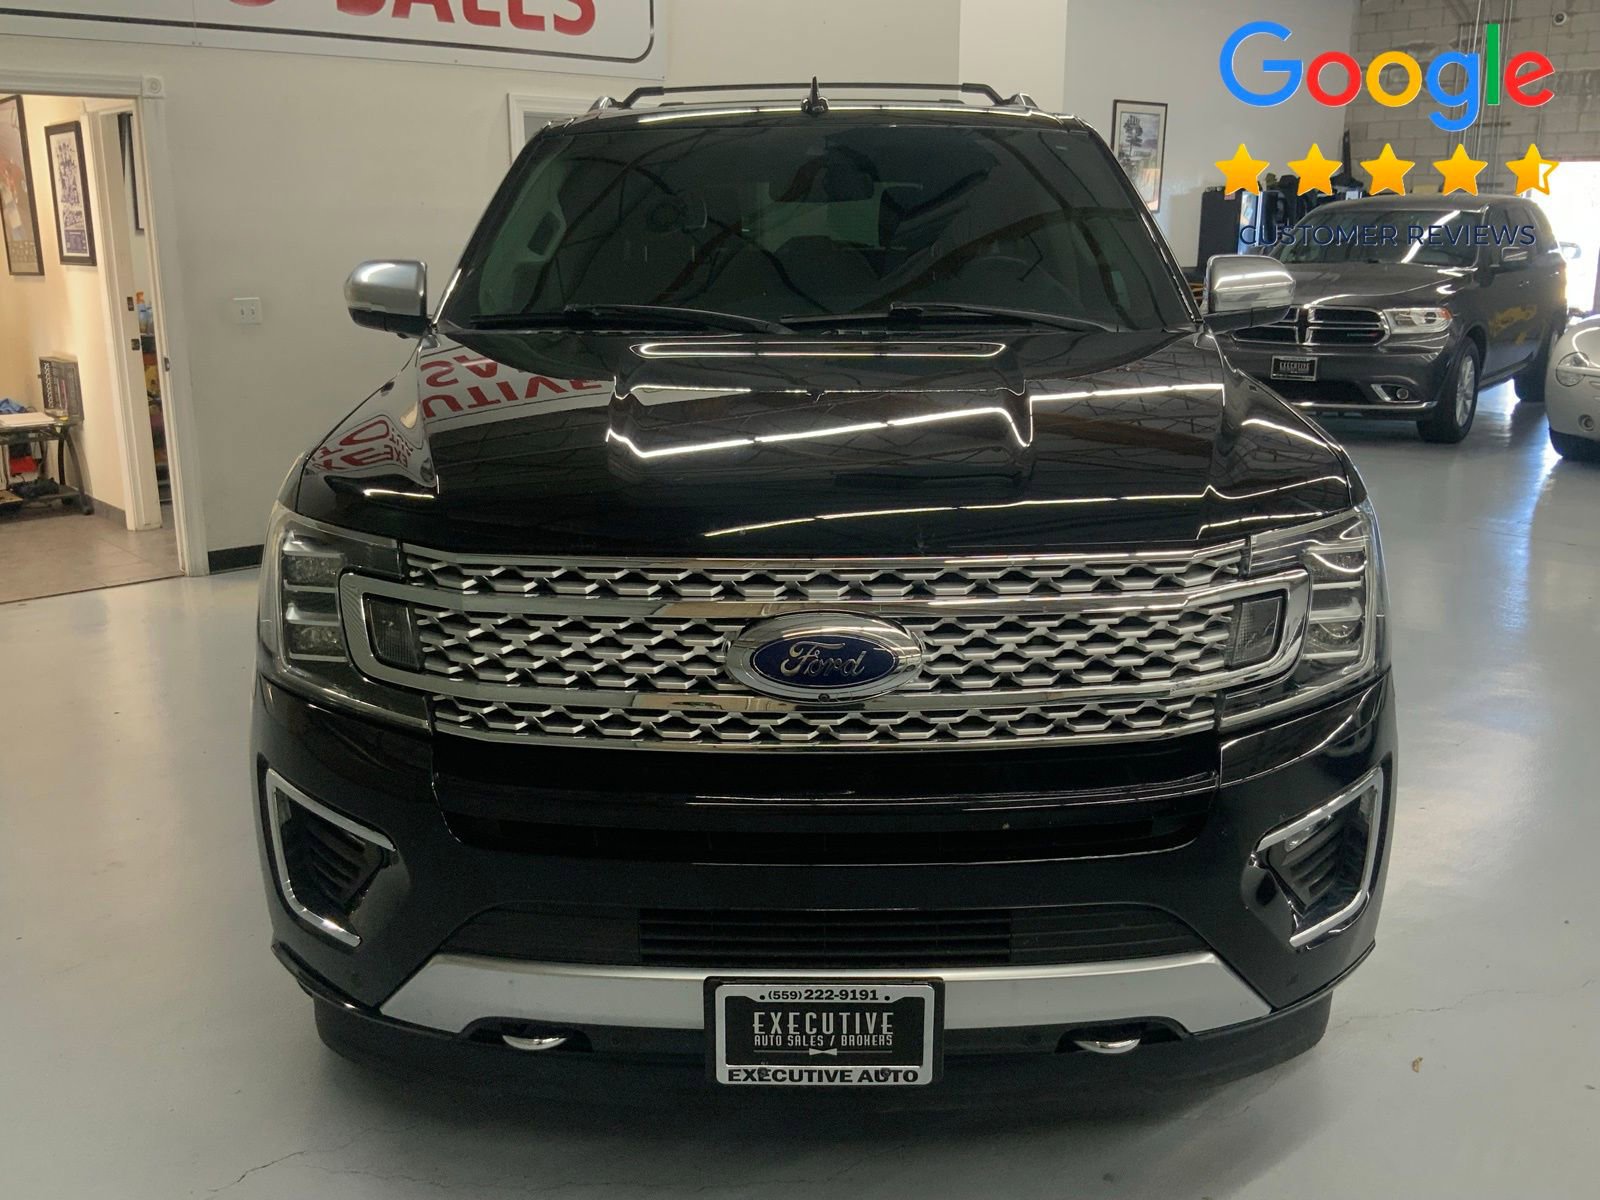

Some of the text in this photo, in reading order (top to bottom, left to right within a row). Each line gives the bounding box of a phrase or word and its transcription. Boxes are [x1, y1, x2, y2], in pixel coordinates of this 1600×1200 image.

[780, 641, 867, 677] Ford
[752, 1012, 894, 1034] EXECUTIVE
[754, 1035, 893, 1047] AUTO SALES / BROKERS
[727, 1068, 919, 1083] EXECUTIVE AUTO
